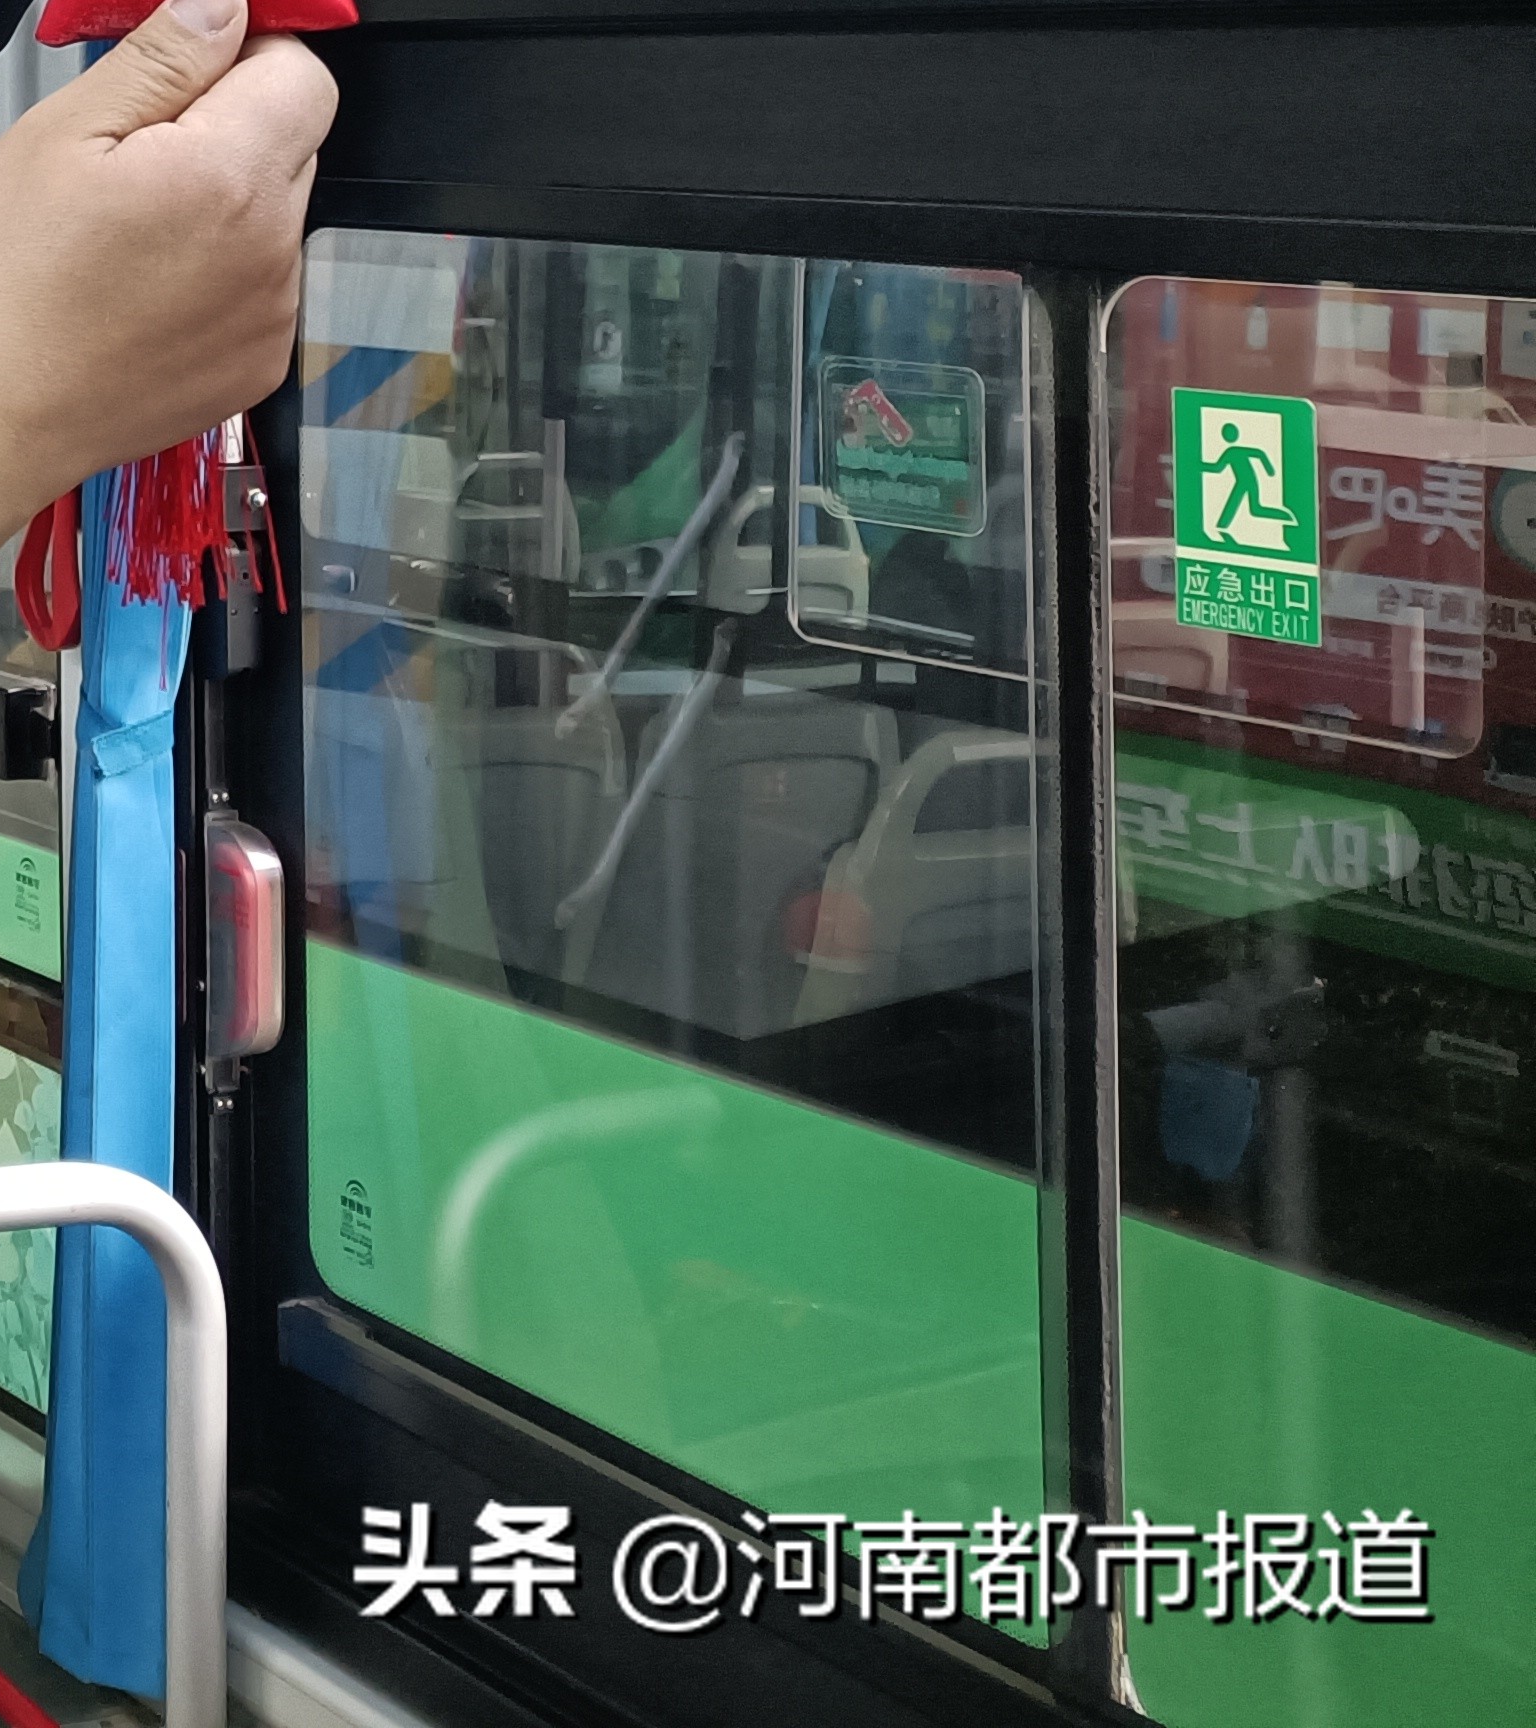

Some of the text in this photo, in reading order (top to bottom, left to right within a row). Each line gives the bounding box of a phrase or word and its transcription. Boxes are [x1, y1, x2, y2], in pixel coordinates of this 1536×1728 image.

[1183, 563, 1310, 612] 应急出口
[1182, 597, 1310, 641] EMERGENCY EXIT
